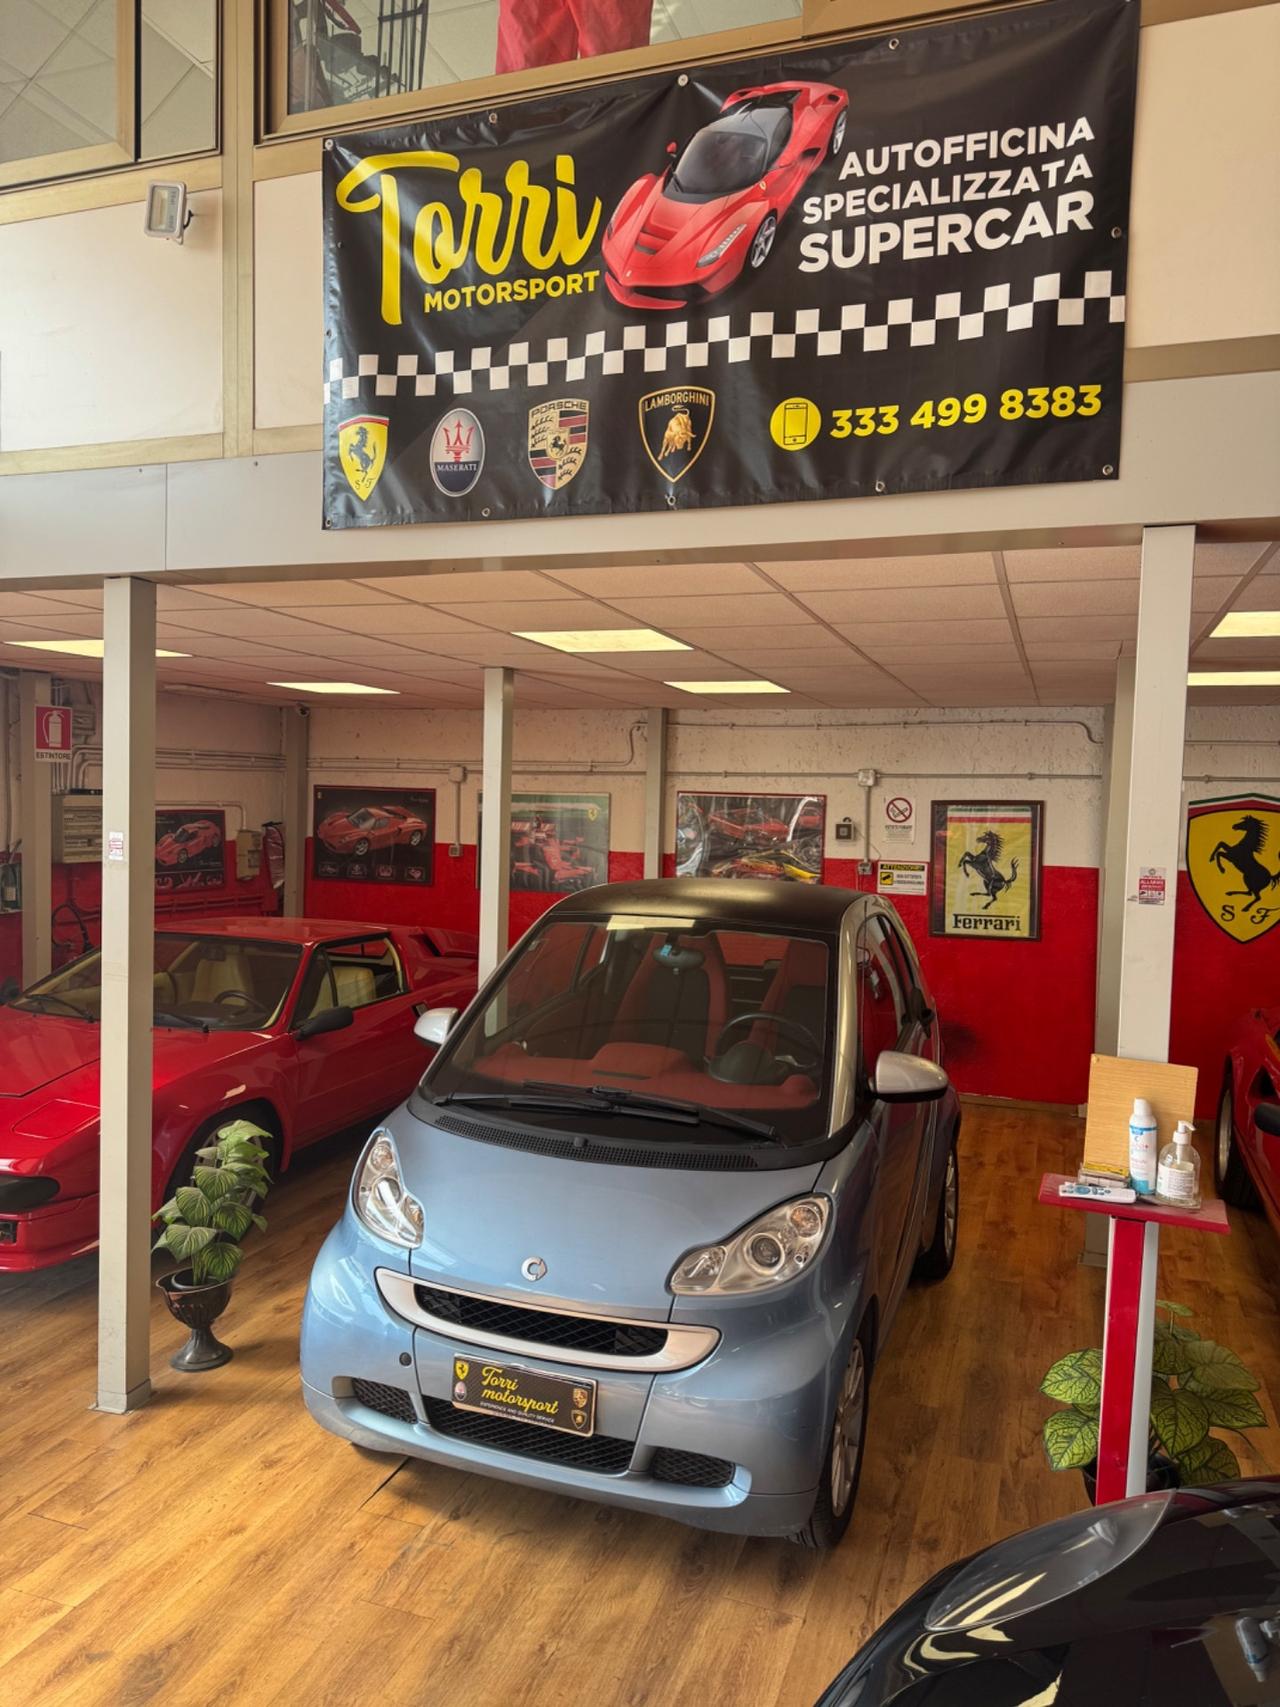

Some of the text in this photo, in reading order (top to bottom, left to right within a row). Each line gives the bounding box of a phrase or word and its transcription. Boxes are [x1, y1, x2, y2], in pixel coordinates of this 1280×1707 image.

[838, 116, 1095, 181] AUTOFFICINA
[802, 153, 1094, 224] SPECIALIZZATA
[336, 150, 602, 325] Torri
[798, 190, 1095, 273] SUPERCAR
[424, 270, 600, 313] MOTORSPORT
[531, 401, 588, 418] PORSCHE
[645, 391, 710, 412] LAMBORGHINI
[830, 384, 1102, 439] 333 499 8383
[437, 463, 477, 472] MASERATI
[36, 751, 71, 760] ESTINTORE
[952, 913, 1021, 931] Ferrari
[482, 1366, 518, 1390] Torri
[481, 1388, 559, 1414] motorsport
